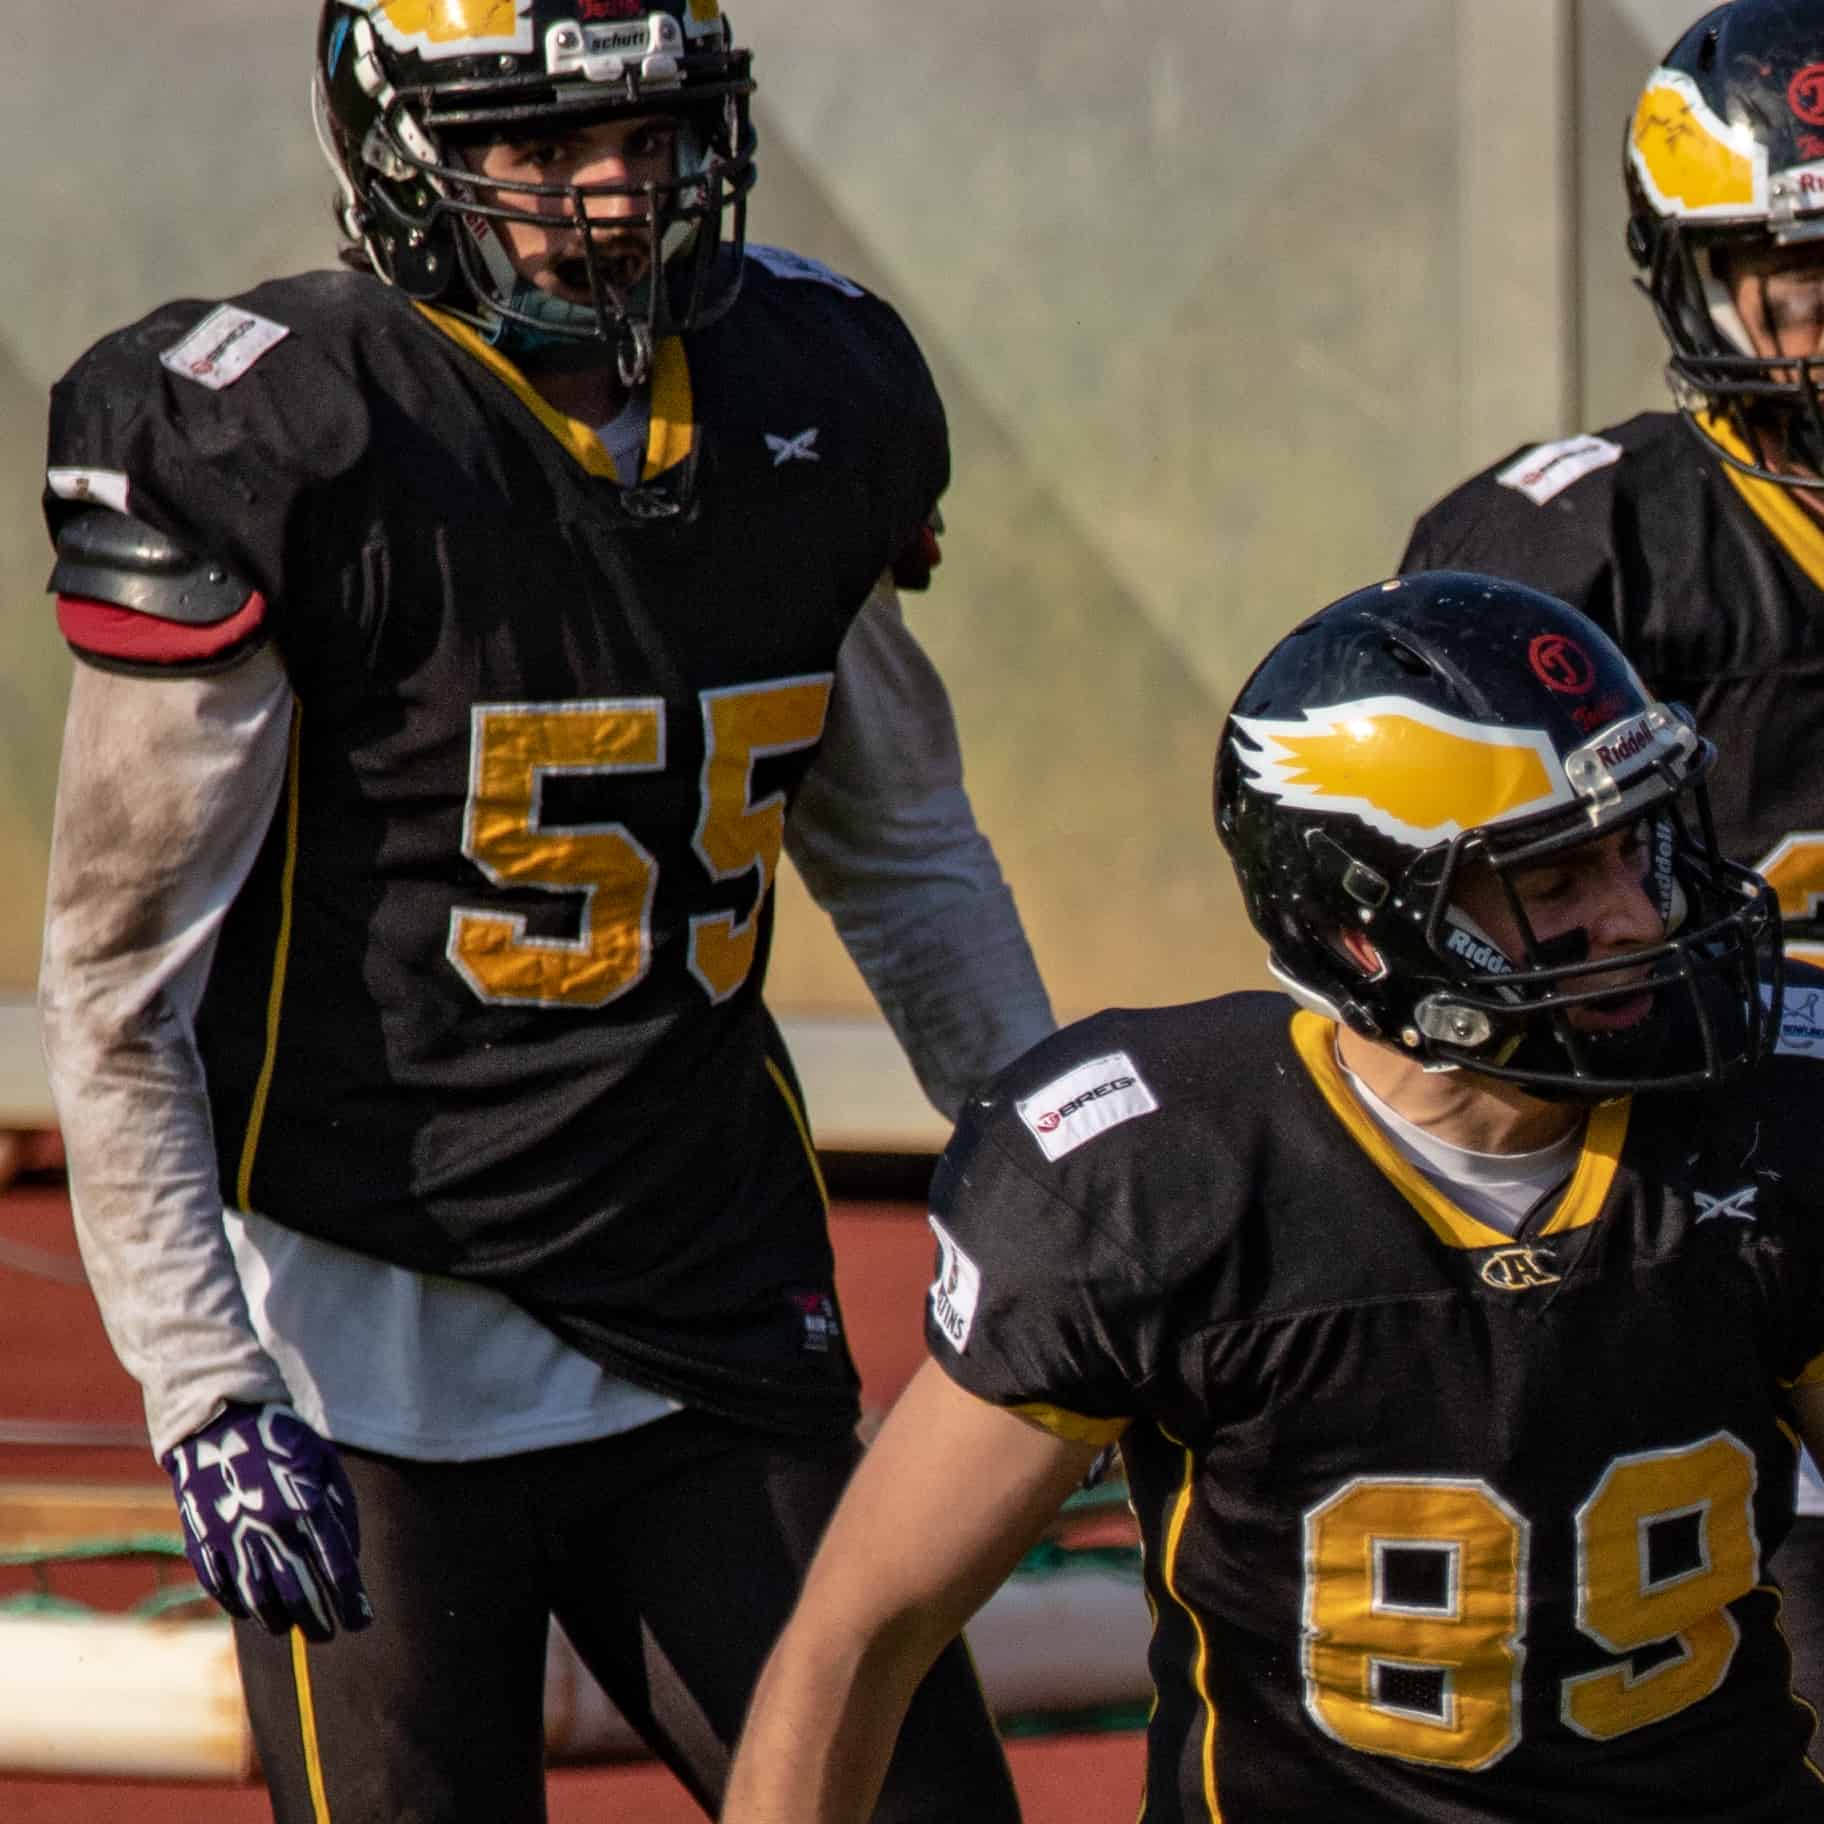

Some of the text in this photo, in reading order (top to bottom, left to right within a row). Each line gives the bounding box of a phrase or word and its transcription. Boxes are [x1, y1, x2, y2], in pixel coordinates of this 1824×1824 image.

[446, 672, 834, 1008] 55
[1596, 719, 1655, 769] Riddell
[1058, 1076, 1134, 1118] BREG
[1301, 1429, 1761, 1772] 89
